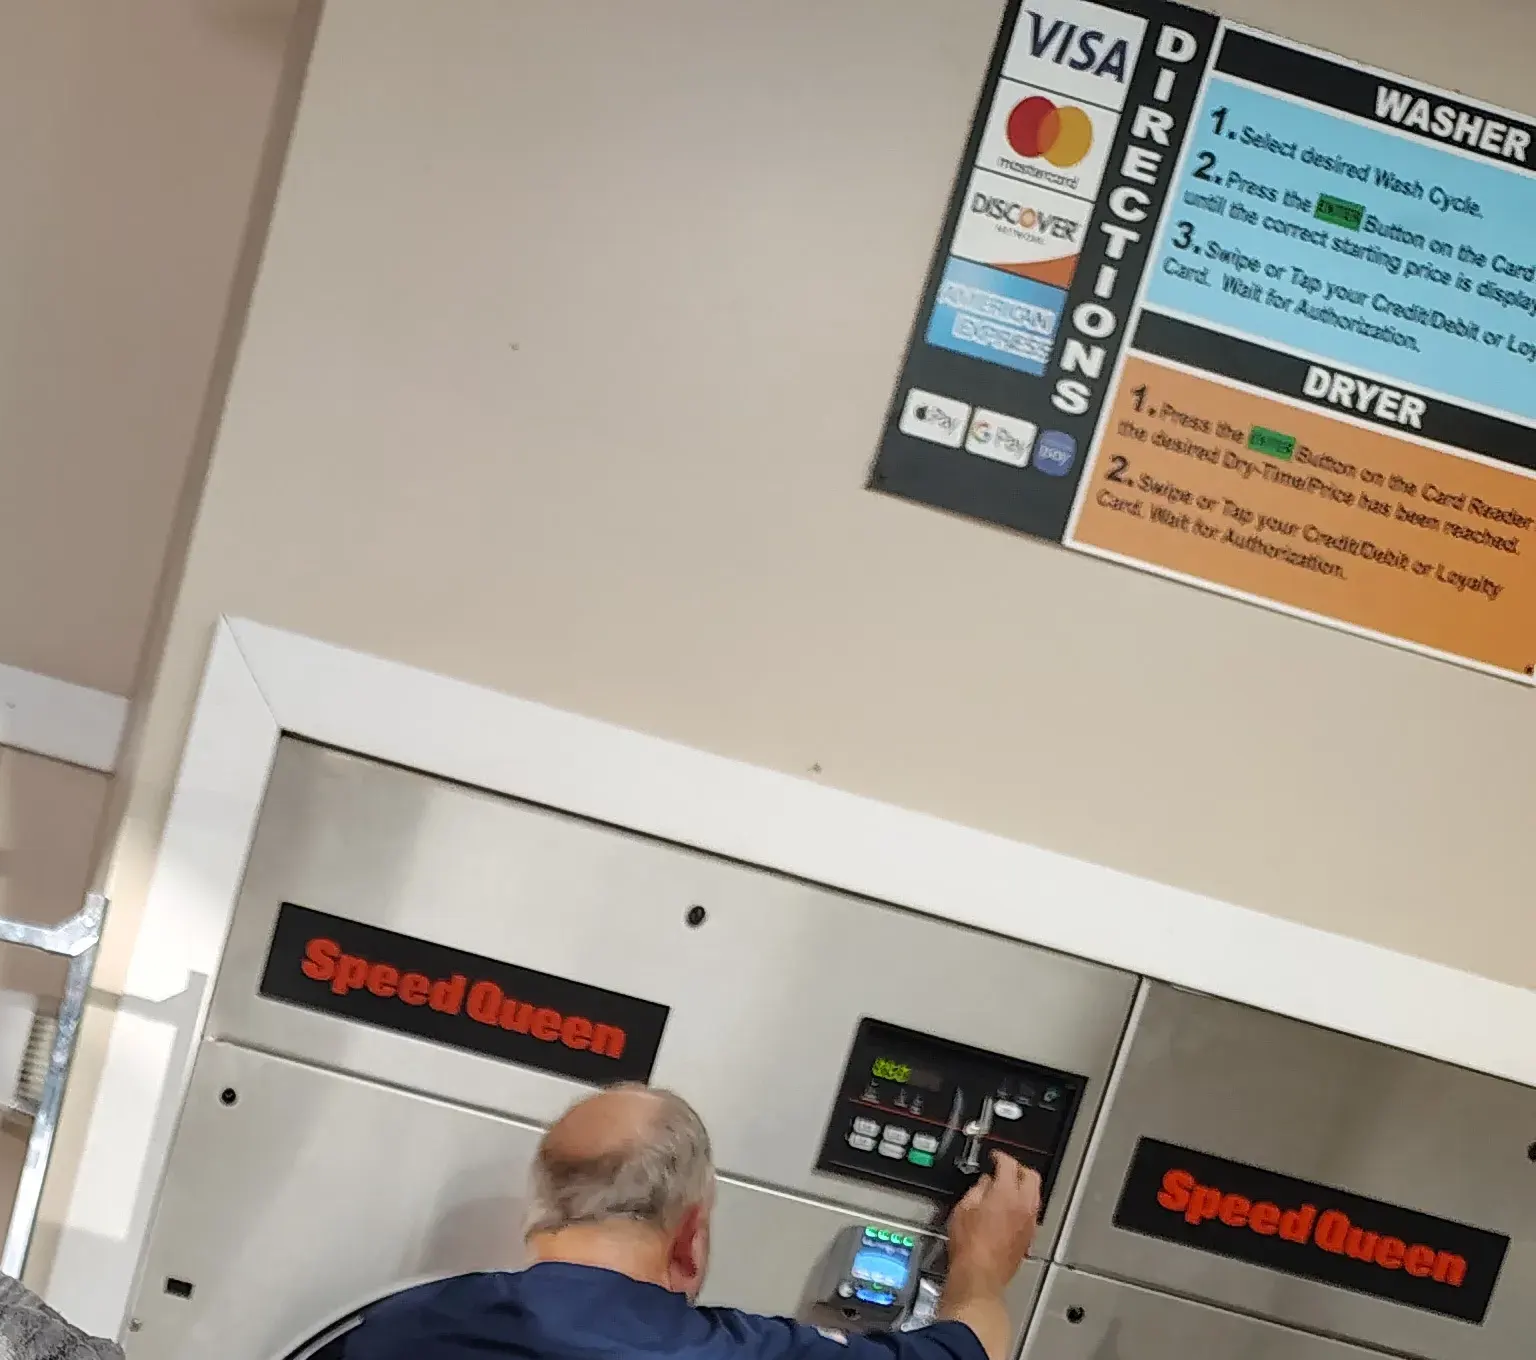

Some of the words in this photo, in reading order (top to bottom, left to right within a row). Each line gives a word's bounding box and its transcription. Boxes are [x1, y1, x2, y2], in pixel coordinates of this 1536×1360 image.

[1024, 9, 1133, 85] VISA
[995, 155, 1081, 190] mastercard
[1209, 106, 1236, 140] 1.
[1237, 125, 1298, 160] Select
[1300, 145, 1371, 182] desired
[1372, 166, 1424, 200] Wash
[1427, 185, 1484, 219] Cycle.
[1374, 86, 1532, 161] WASHER
[970, 192, 1081, 244] DISCOVER
[1050, 24, 1197, 417] DIRECTIONS
[1183, 189, 1228, 216] until
[1228, 201, 1259, 226] the
[1262, 213, 1330, 250] correct
[1330, 235, 1403, 275] starting
[1403, 260, 1453, 288] price
[1455, 274, 1473, 294] is
[1191, 151, 1223, 186] 2.
[1224, 171, 1279, 203] Press
[1282, 189, 1312, 213] the
[1364, 213, 1426, 249] Button
[1427, 237, 1454, 258] on
[1456, 244, 1488, 268] the
[1170, 220, 1201, 254] 3.
[1204, 239, 1262, 273] Swipe
[1264, 261, 1289, 281] or
[1290, 265, 1323, 294] Tap
[1323, 279, 1368, 307] your
[1482, 329, 1505, 348] or
[1221, 272, 1265, 303] Wait
[1265, 287, 1295, 313] for
[1302, 365, 1429, 431] DRYER
[1116, 419, 1149, 443] the
[1150, 430, 1219, 466] desired
[1358, 490, 1392, 520] has
[1394, 502, 1441, 531] been
[1130, 383, 1157, 418] 1.
[1158, 402, 1214, 435] Press
[1214, 420, 1245, 444] the
[1294, 444, 1358, 480] Button
[1359, 467, 1385, 488] on
[1387, 473, 1418, 498] the
[1420, 483, 1466, 513] Card
[1466, 497, 1534, 532] Reader
[1104, 453, 1135, 488] 2.
[1137, 473, 1195, 508] Swipe
[1196, 492, 1221, 512] or
[1221, 496, 1255, 527] Tap
[1256, 514, 1301, 541] your
[1410, 559, 1435, 578] or
[1434, 562, 1505, 603] Loyalty
[1148, 503, 1193, 534] Wait
[1191, 518, 1220, 542] for
[302, 938, 466, 1014] Speed
[467, 981, 625, 1057] Queen
[1158, 1170, 1317, 1243] Speed
[1315, 1211, 1465, 1284] Queen
